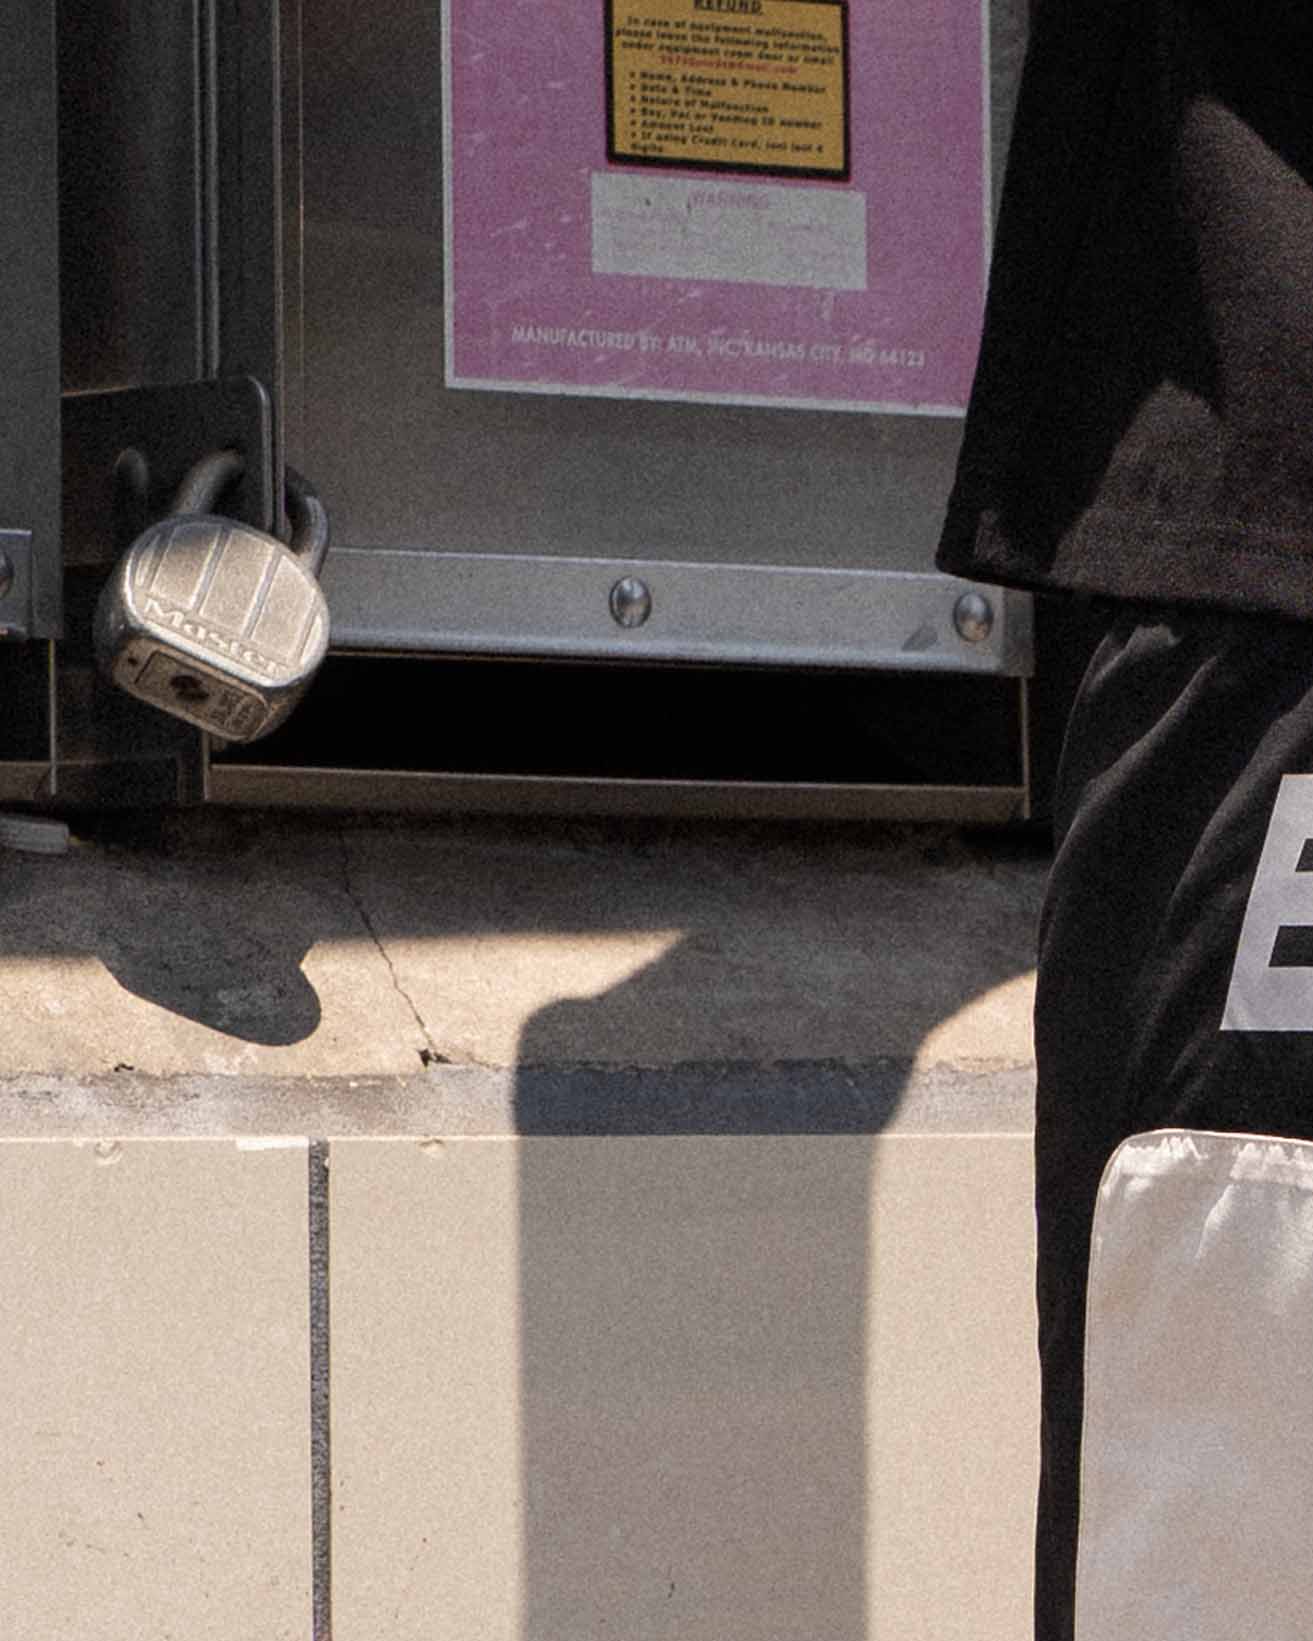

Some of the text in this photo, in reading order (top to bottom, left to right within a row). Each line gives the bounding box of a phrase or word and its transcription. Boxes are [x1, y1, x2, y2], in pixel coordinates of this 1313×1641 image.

[681, 74, 727, 86] Address
[512, 326, 634, 349] MANUFACTURED
[142, 594, 290, 675] Master
